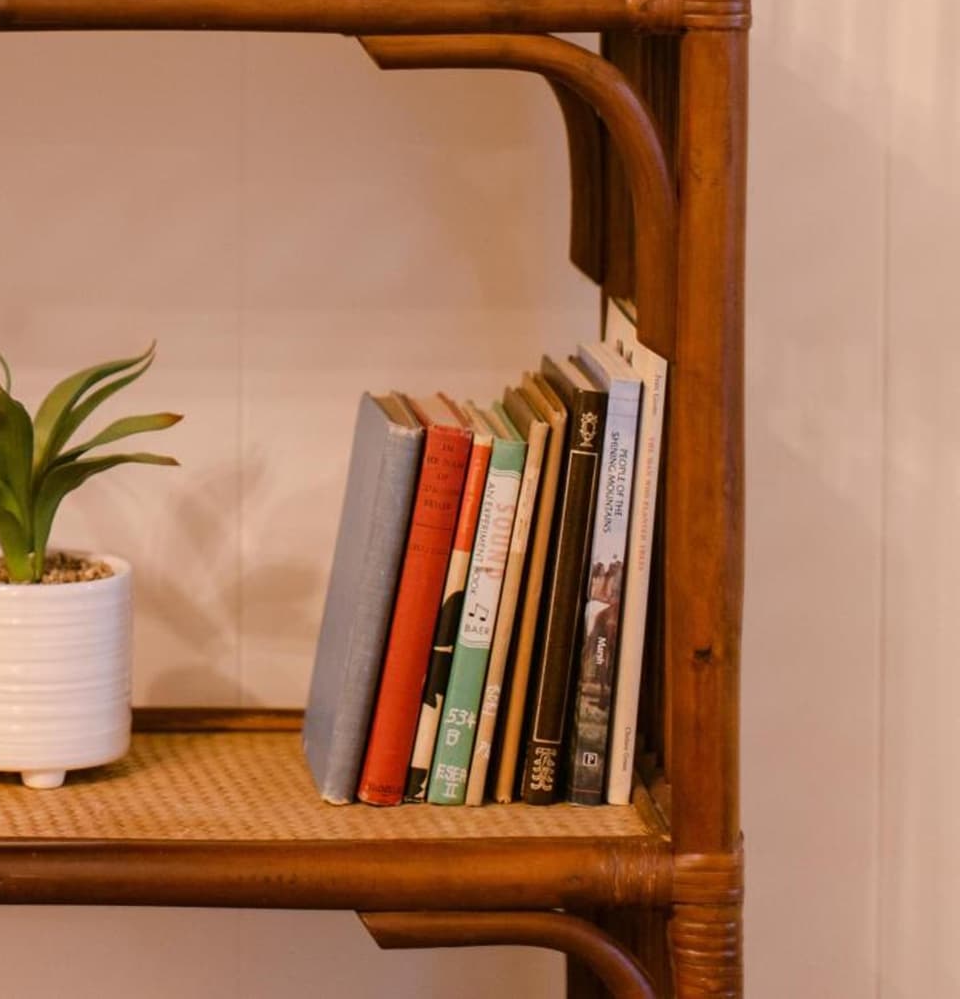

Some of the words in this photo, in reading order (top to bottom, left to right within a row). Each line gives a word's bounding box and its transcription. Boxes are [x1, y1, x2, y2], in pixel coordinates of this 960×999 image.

[607, 431, 620, 473] SHINING
[617, 449, 628, 483] PEOPLE
[486, 481, 497, 499] AN
[603, 475, 616, 533] MOUNTAINS
[616, 486, 625, 500] OF
[614, 502, 624, 517] THE
[475, 501, 493, 563] EXPERIMENT
[596, 636, 607, 665] Marsh
